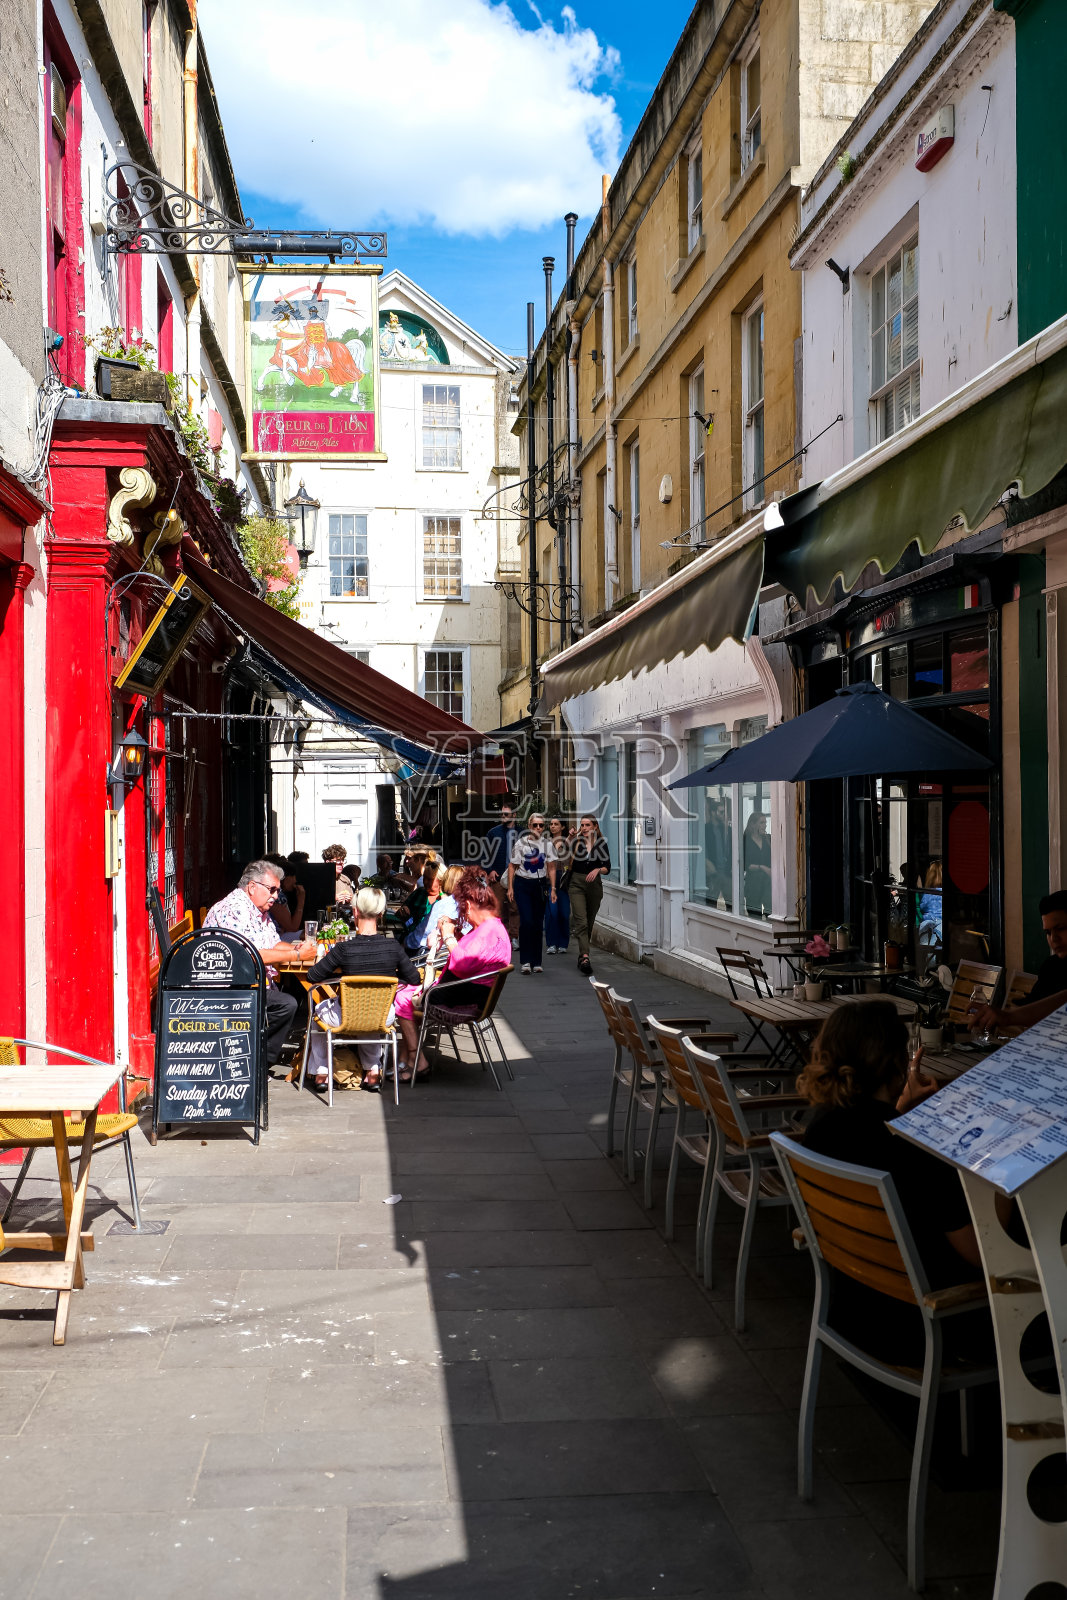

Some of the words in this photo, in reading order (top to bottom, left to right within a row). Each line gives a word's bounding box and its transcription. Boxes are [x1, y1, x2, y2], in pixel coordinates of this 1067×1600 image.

[314, 422, 325, 431] DE
[291, 437, 319, 450] Abbey
[321, 437, 339, 447] Ales
[200, 950, 224, 961] COEUR
[208, 960, 228, 970] LION
[169, 998, 228, 1014] Welcome
[168, 1017, 206, 1035] COEUR
[207, 1022, 220, 1031] DE
[167, 1041, 216, 1054] BREAKFAST
[225, 1038, 239, 1047] 10am
[166, 1063, 190, 1076] MAIN
[190, 1063, 216, 1076] MENU
[166, 1084, 208, 1107] Sunday
[209, 1084, 250, 1100] ROAST
[183, 1104, 205, 1119] 12pm
[213, 1104, 232, 1119] 5pm
